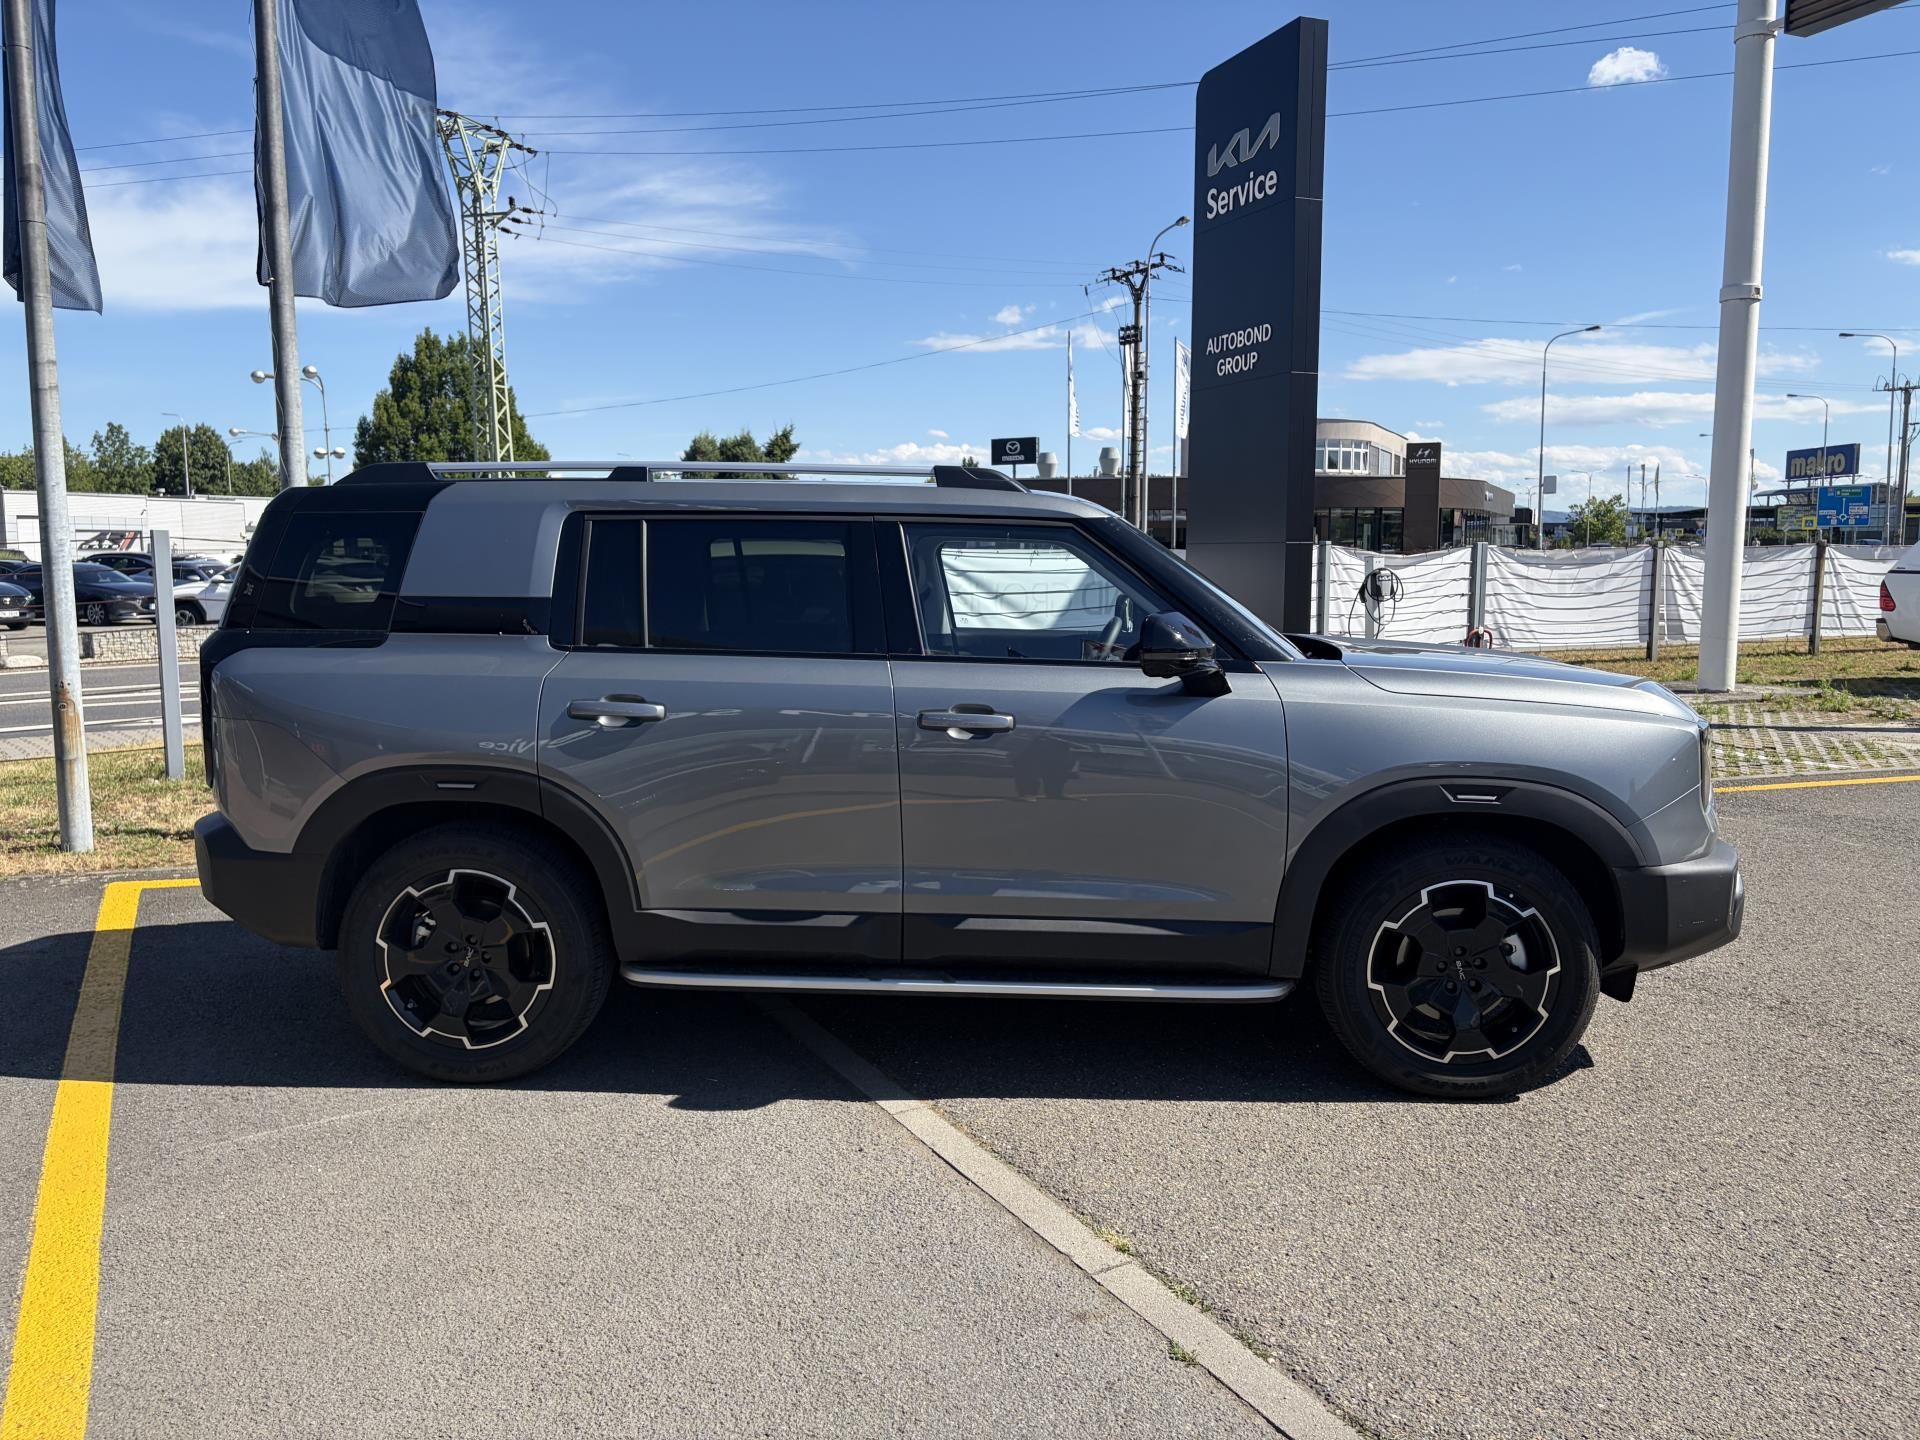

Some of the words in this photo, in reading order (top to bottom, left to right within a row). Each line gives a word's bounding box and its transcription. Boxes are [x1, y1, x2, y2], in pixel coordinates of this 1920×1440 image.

[1207, 112, 1281, 177] KIA
[1206, 170, 1277, 220] Service
[1206, 323, 1272, 356] AUTOBOND
[1216, 351, 1258, 377] GROUP
[1790, 449, 1846, 477] makro
